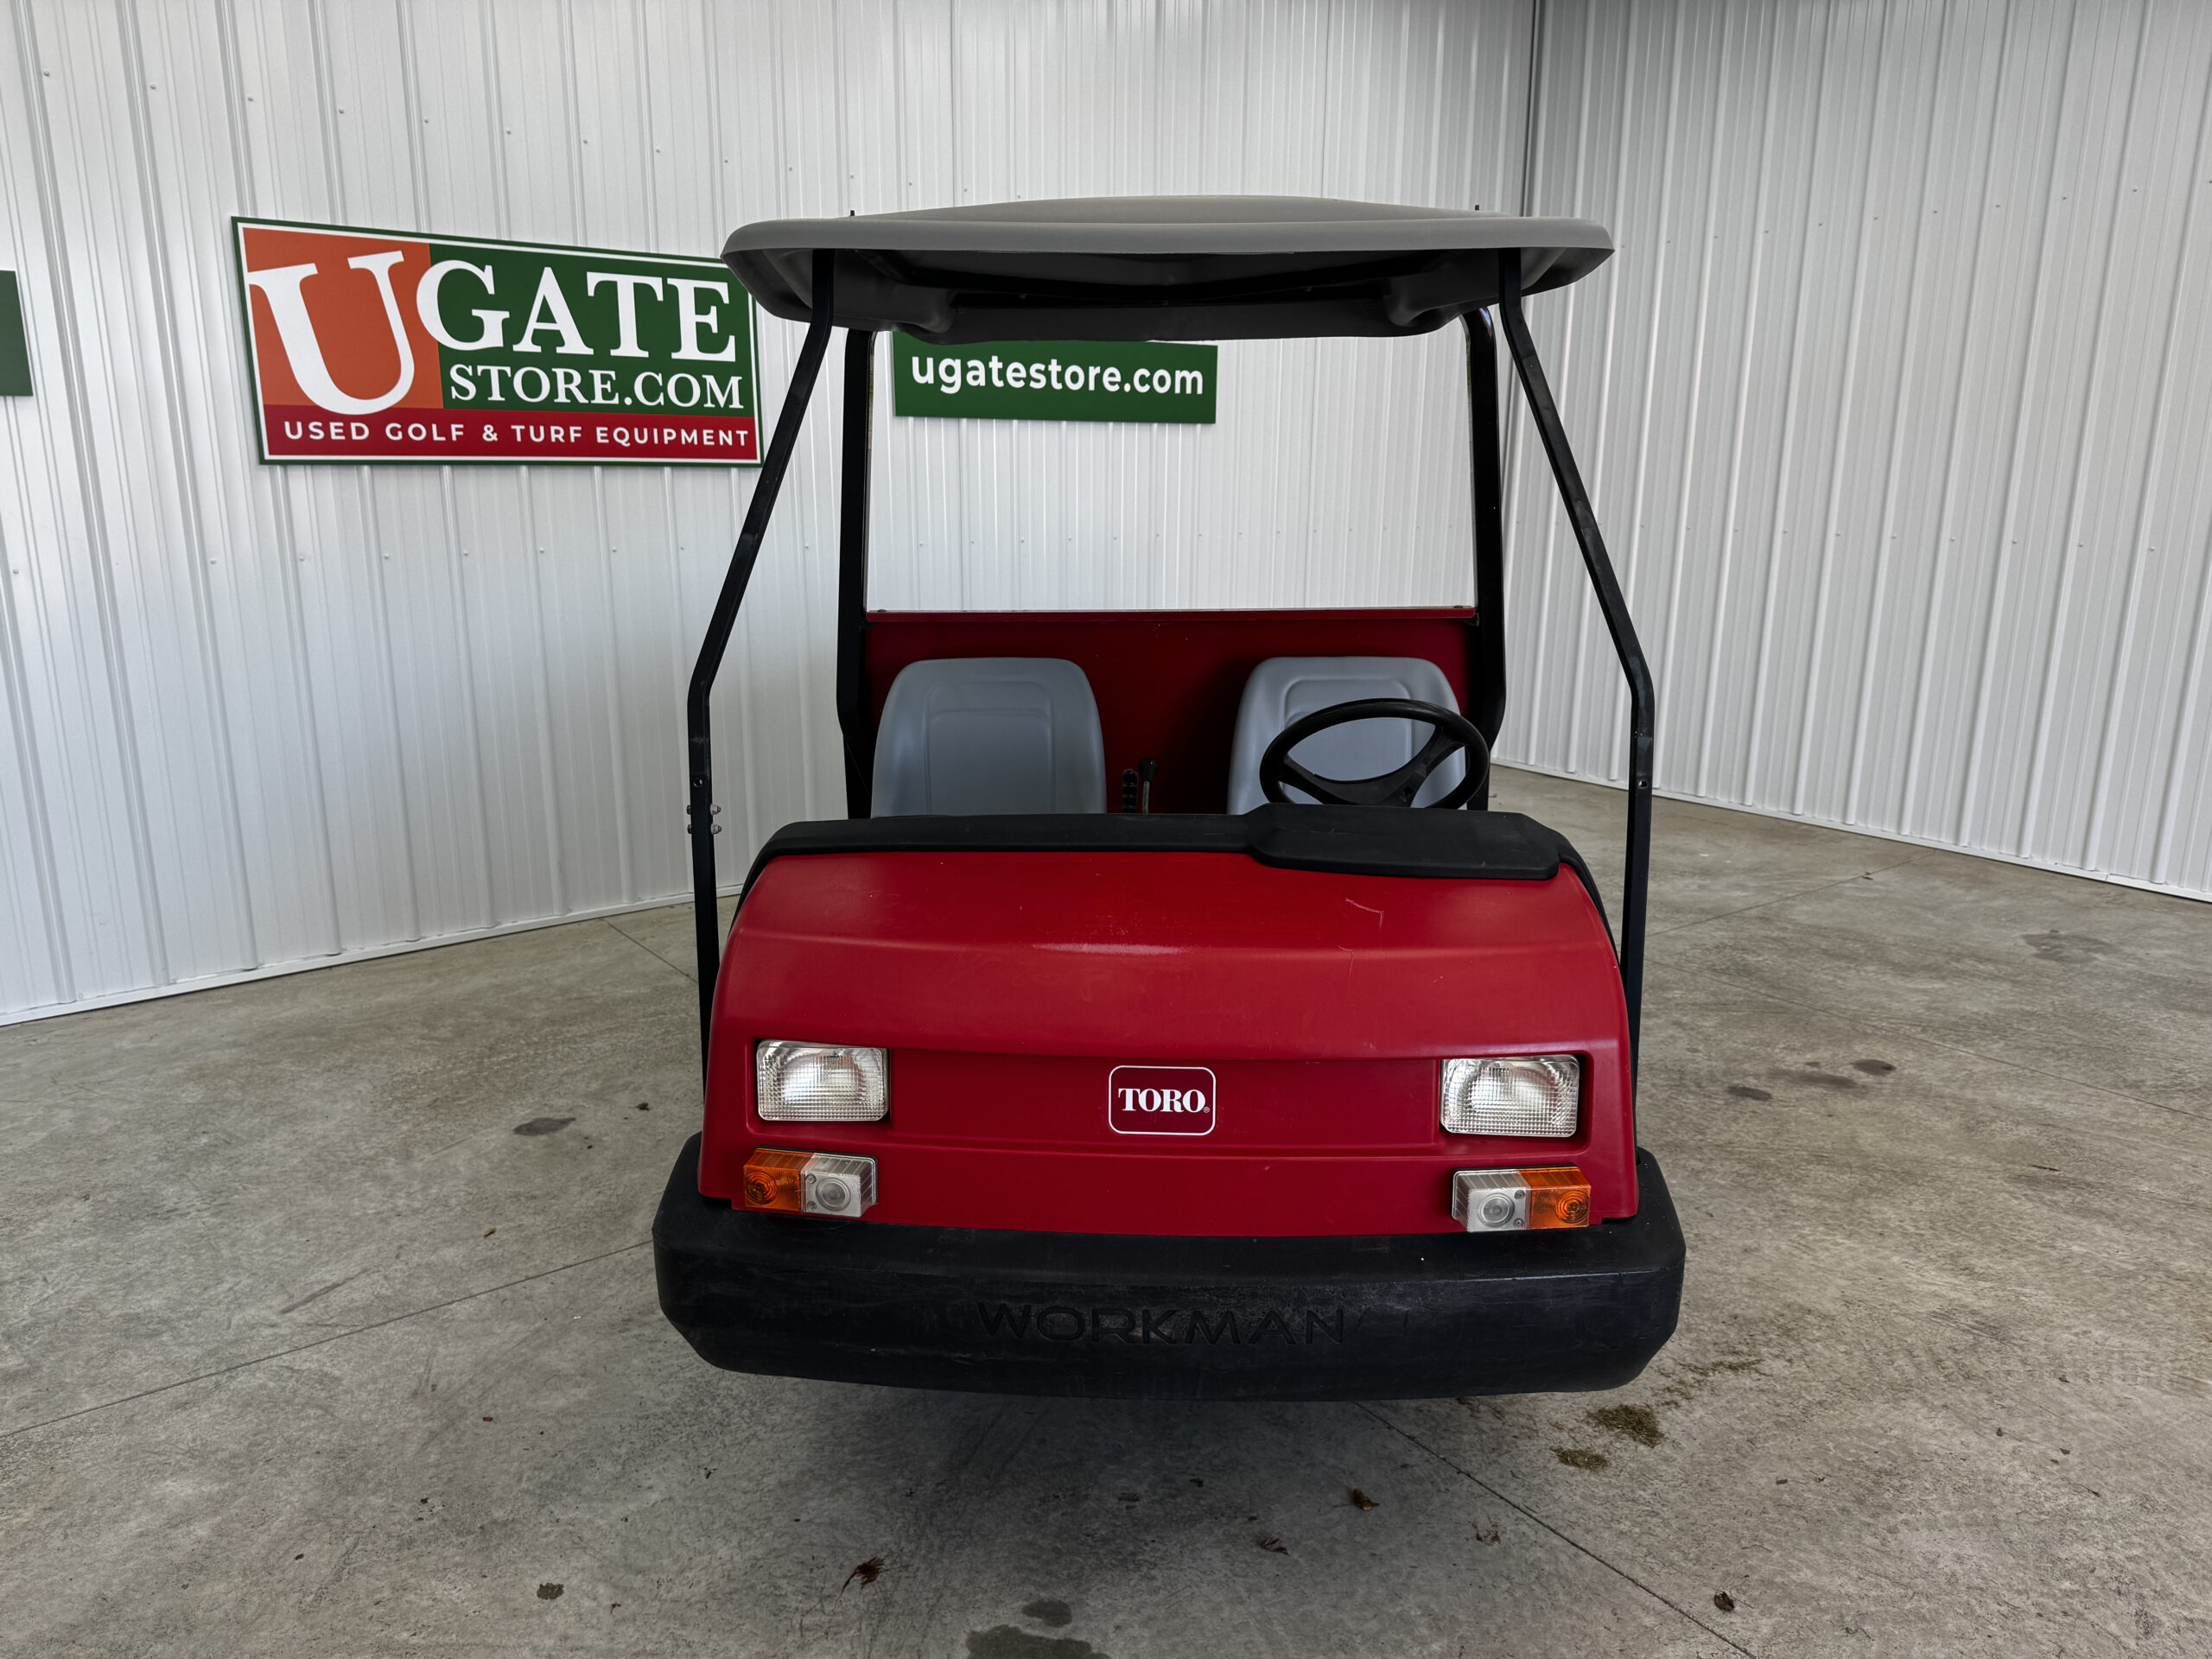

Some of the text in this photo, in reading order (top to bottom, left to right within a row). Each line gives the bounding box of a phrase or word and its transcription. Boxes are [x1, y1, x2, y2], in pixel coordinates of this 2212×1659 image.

[249, 250, 736, 416] UGATE
[449, 363, 744, 410] STORE.COM
[912, 355, 1203, 395] ugatestore.com
[284, 420, 750, 448] USED GOLF & TURF EQUIPMENT
[976, 1300, 1344, 1345] WORKMAN
